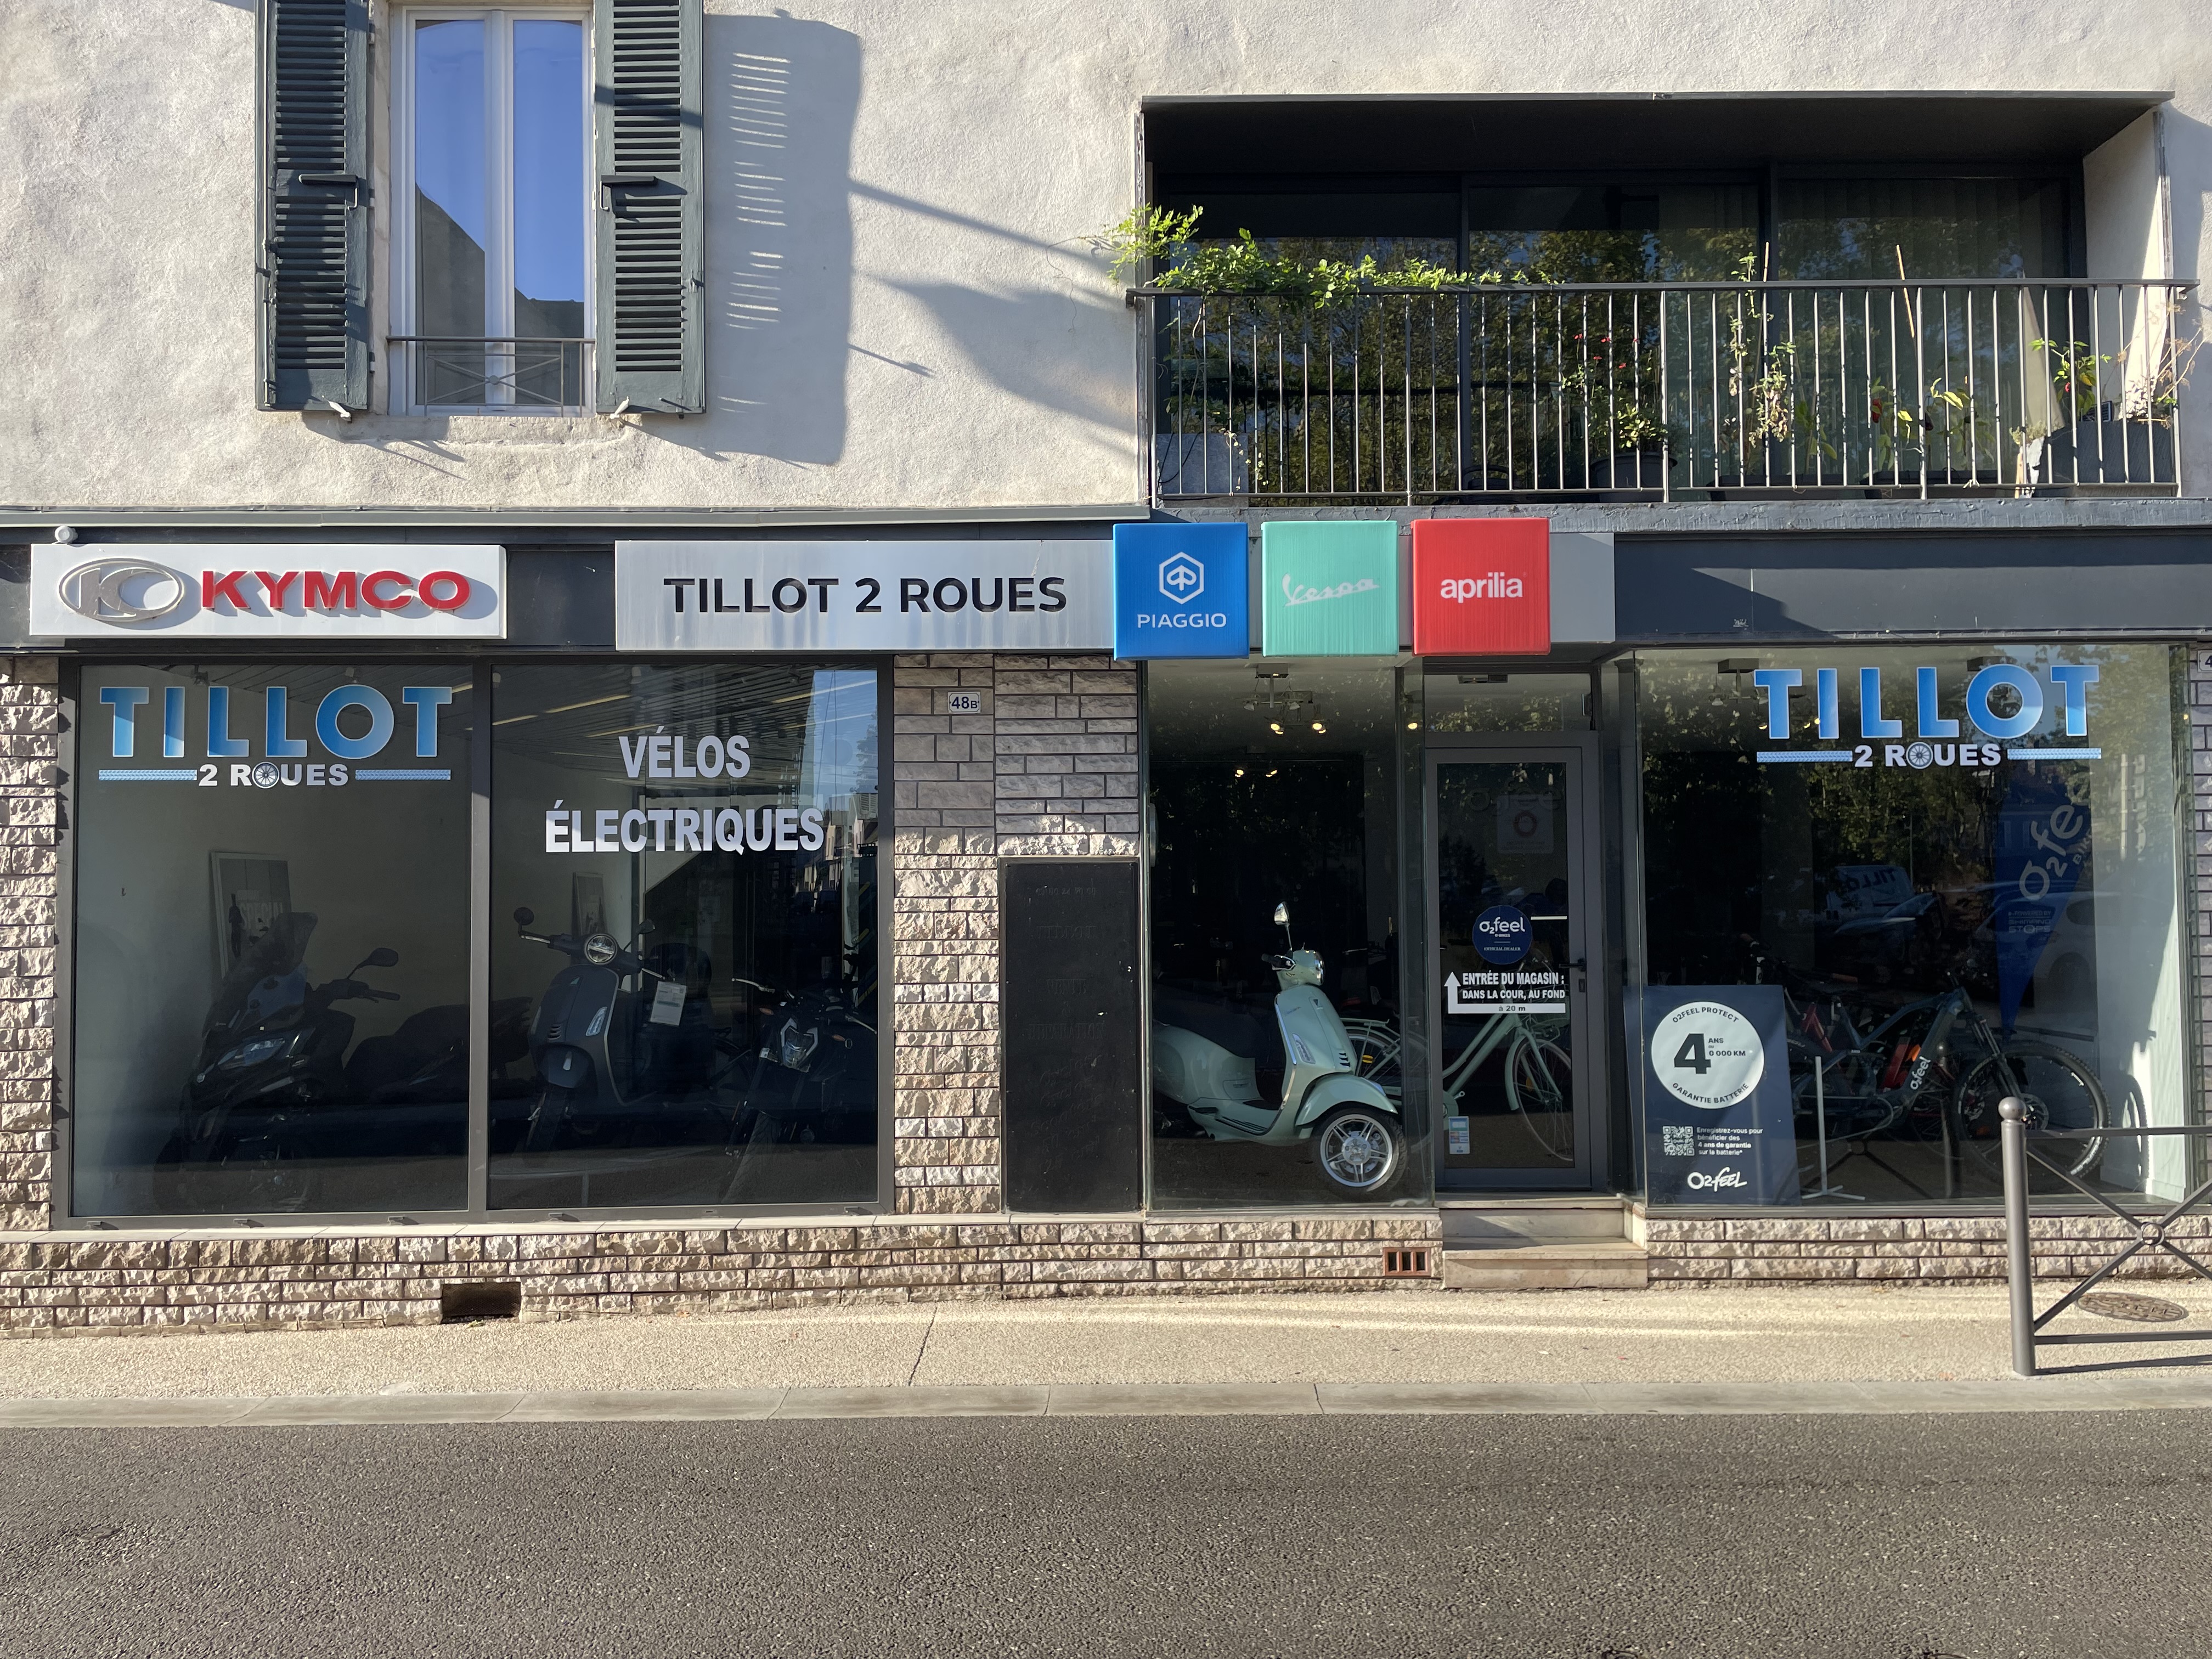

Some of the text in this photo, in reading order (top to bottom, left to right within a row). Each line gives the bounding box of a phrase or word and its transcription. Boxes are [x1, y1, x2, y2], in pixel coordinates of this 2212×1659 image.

[202, 571, 472, 610] KYMCO
[663, 577, 1066, 613] TILLOT 2 ROUES
[1282, 573, 1380, 607] Vespa
[1441, 572, 1523, 604] aprilia
[1137, 613, 1227, 628] PIAGGIO
[951, 696, 978, 709] 48B
[1754, 664, 2100, 740] TILLOT
[99, 684, 453, 759] TILLOT
[619, 726, 751, 778] VÉLOS
[1854, 742, 2002, 769] 2 ROUES
[199, 761, 349, 789] 2 ROUES
[546, 800, 824, 853] ÉLECTRIQUES
[1462, 970, 1499, 985] ENTRÉE
[1501, 972, 1515, 985] DU
[1516, 972, 1559, 985] MAGASIN
[1462, 989, 1566, 1000] DANS LA COUR, AU FOND
[1701, 1007, 1739, 1022] PROTECT
[1674, 1033, 1712, 1074] 4
[1672, 1082, 1749, 1103] GARANTIE BATTERIE
